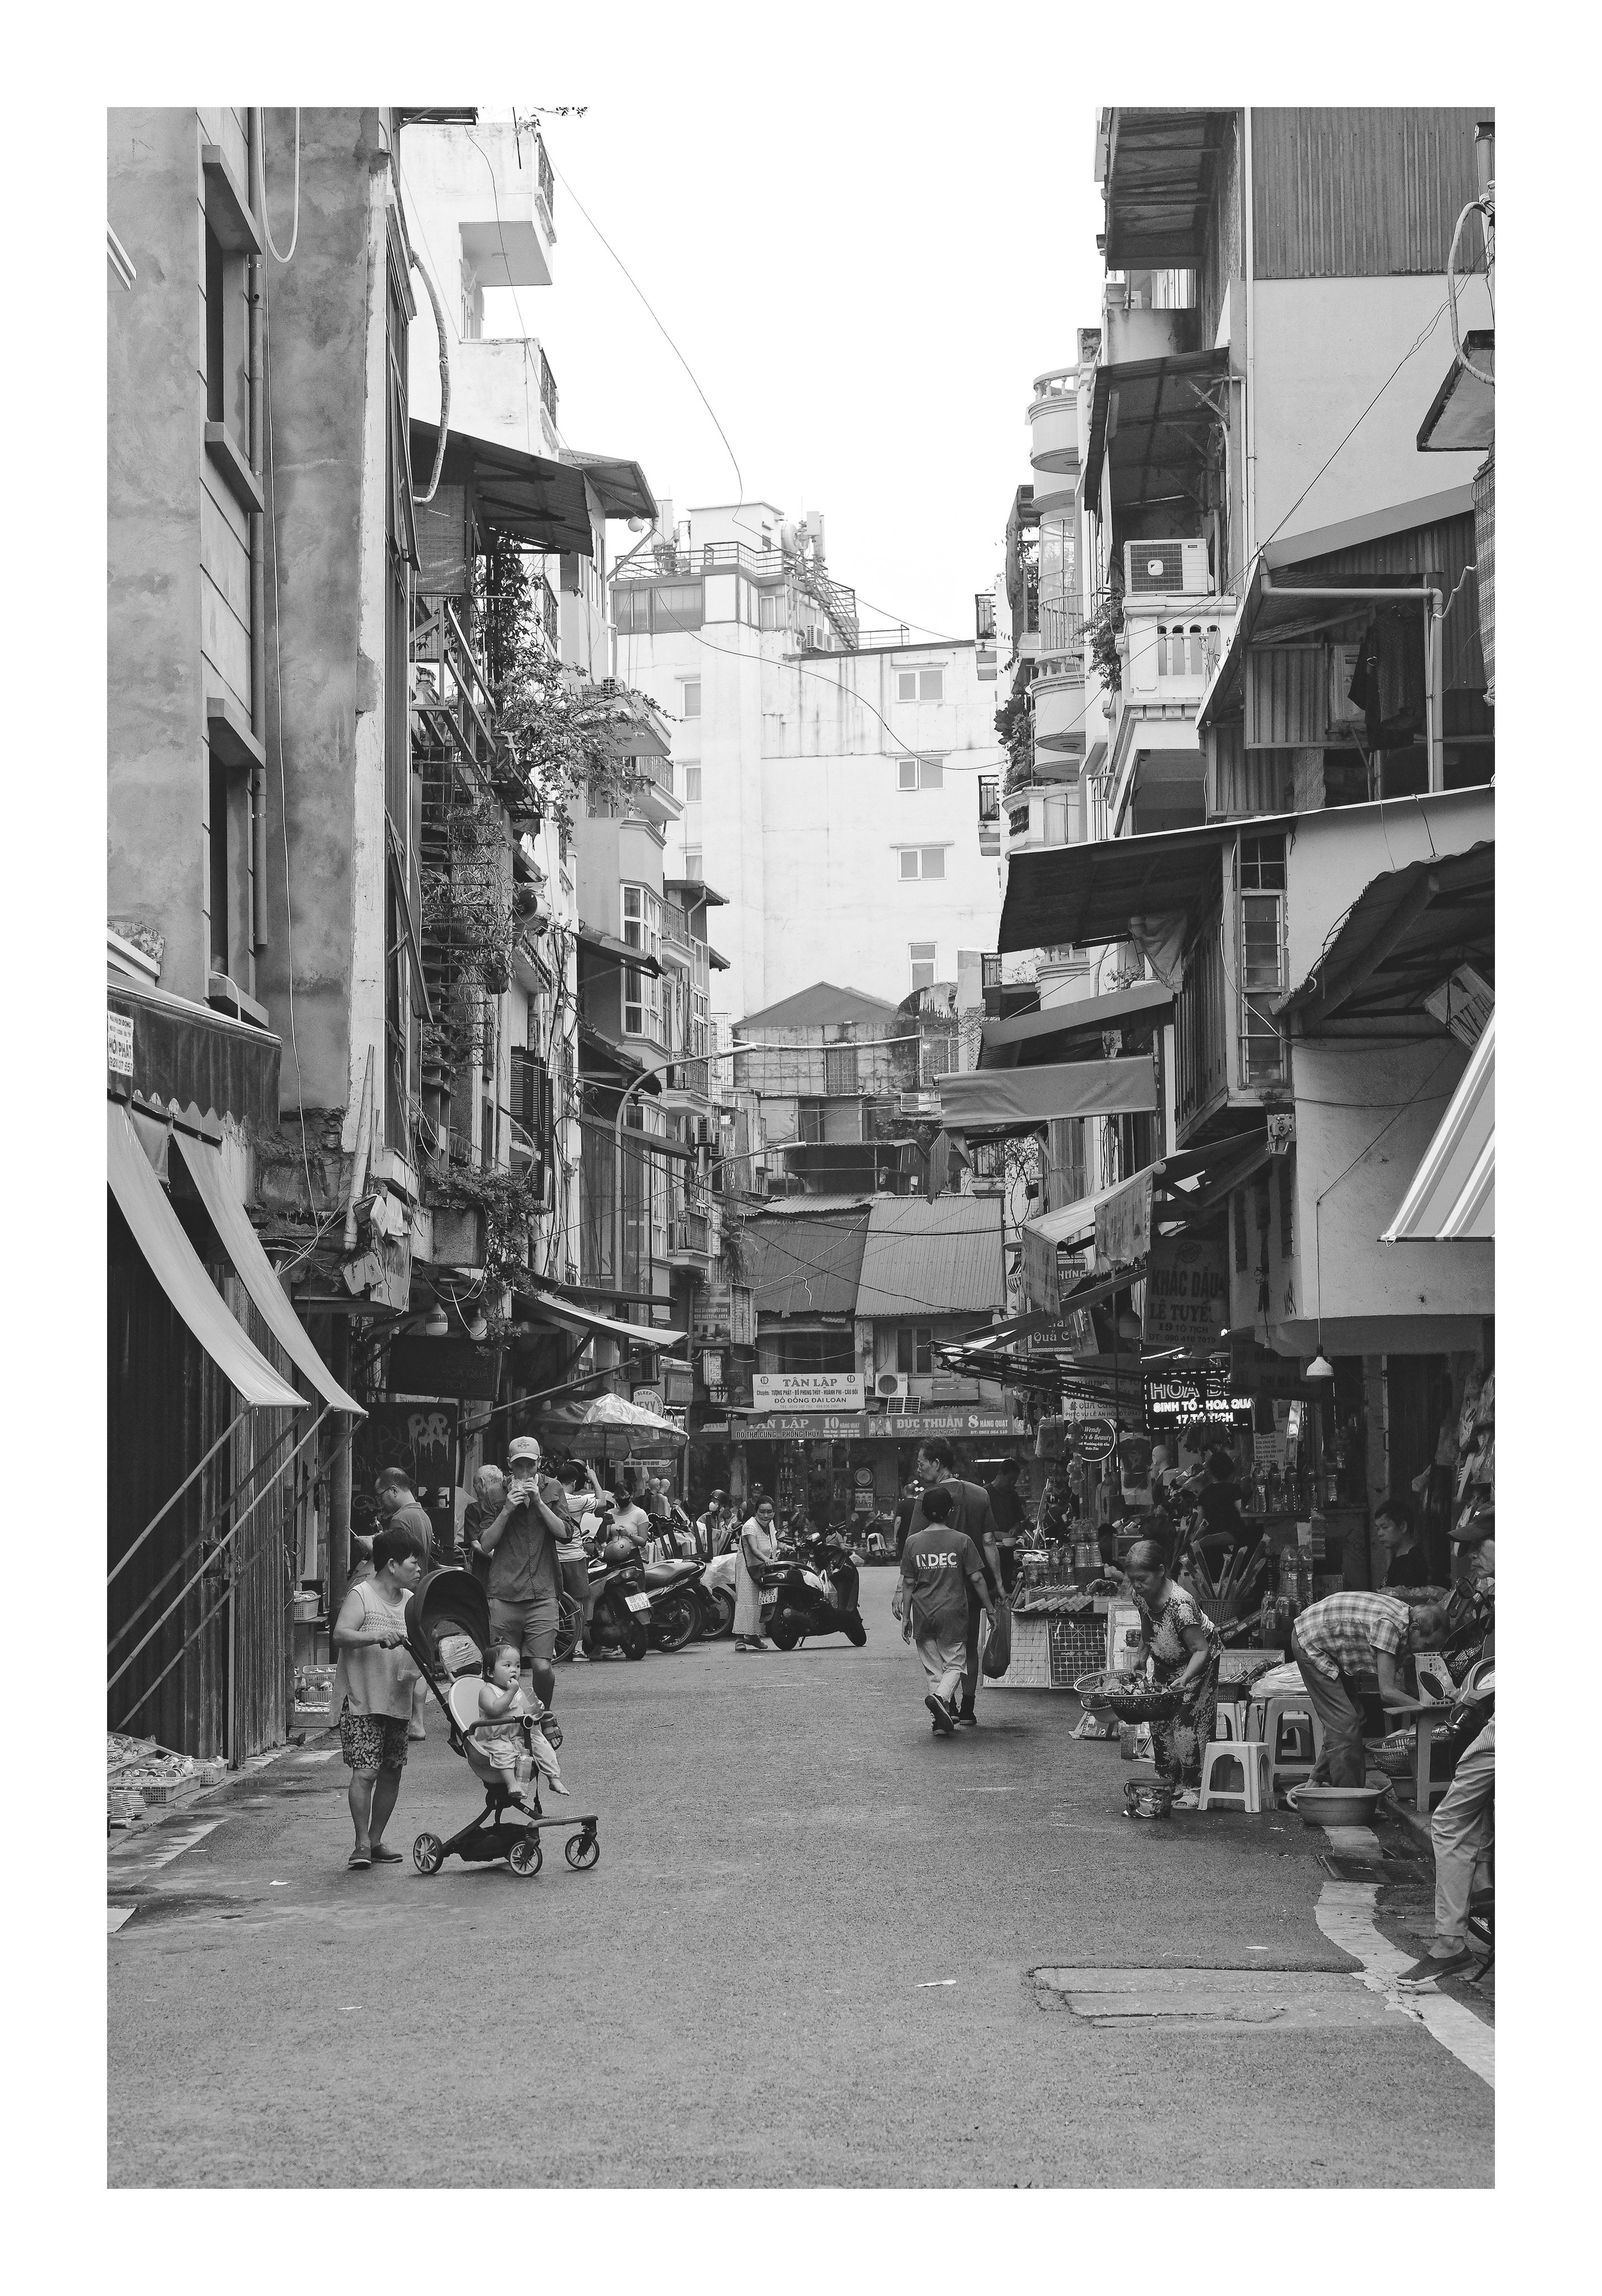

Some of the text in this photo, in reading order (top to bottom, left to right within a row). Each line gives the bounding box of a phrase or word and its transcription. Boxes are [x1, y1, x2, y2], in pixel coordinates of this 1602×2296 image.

[1158, 1322, 1208, 1334] 19 TÔ TỊCH
[783, 1377, 838, 1389] TÂN LẬP
[1150, 1379, 1200, 1399] HOA
[654, 1396, 662, 1417] DISCOVE
[1153, 1402, 1180, 1412] SINH
[1181, 1397, 1197, 1411] TỐ
[1205, 1399, 1229, 1411] HOA
[781, 1417, 809, 1431] LẬP
[824, 1417, 839, 1429] 10
[897, 1417, 920, 1428] ĐỨC
[968, 1415, 979, 1428] 8
[980, 1419, 994, 1427] HÀNG
[995, 1419, 1008, 1429] QUẠT
[1176, 1414, 1189, 1424] 17
[737, 1429, 745, 1438] ĐỒ
[759, 1429, 777, 1438] CÚNG
[1084, 1426, 1101, 1434] Wendy
[660, 1432, 680, 1441] NowFod
[1094, 1434, 1112, 1442] Beauty
[916, 1552, 957, 1568] INDEC
[628, 1594, 645, 1604] 88-H1
[630, 1600, 649, 1611] 386.97
